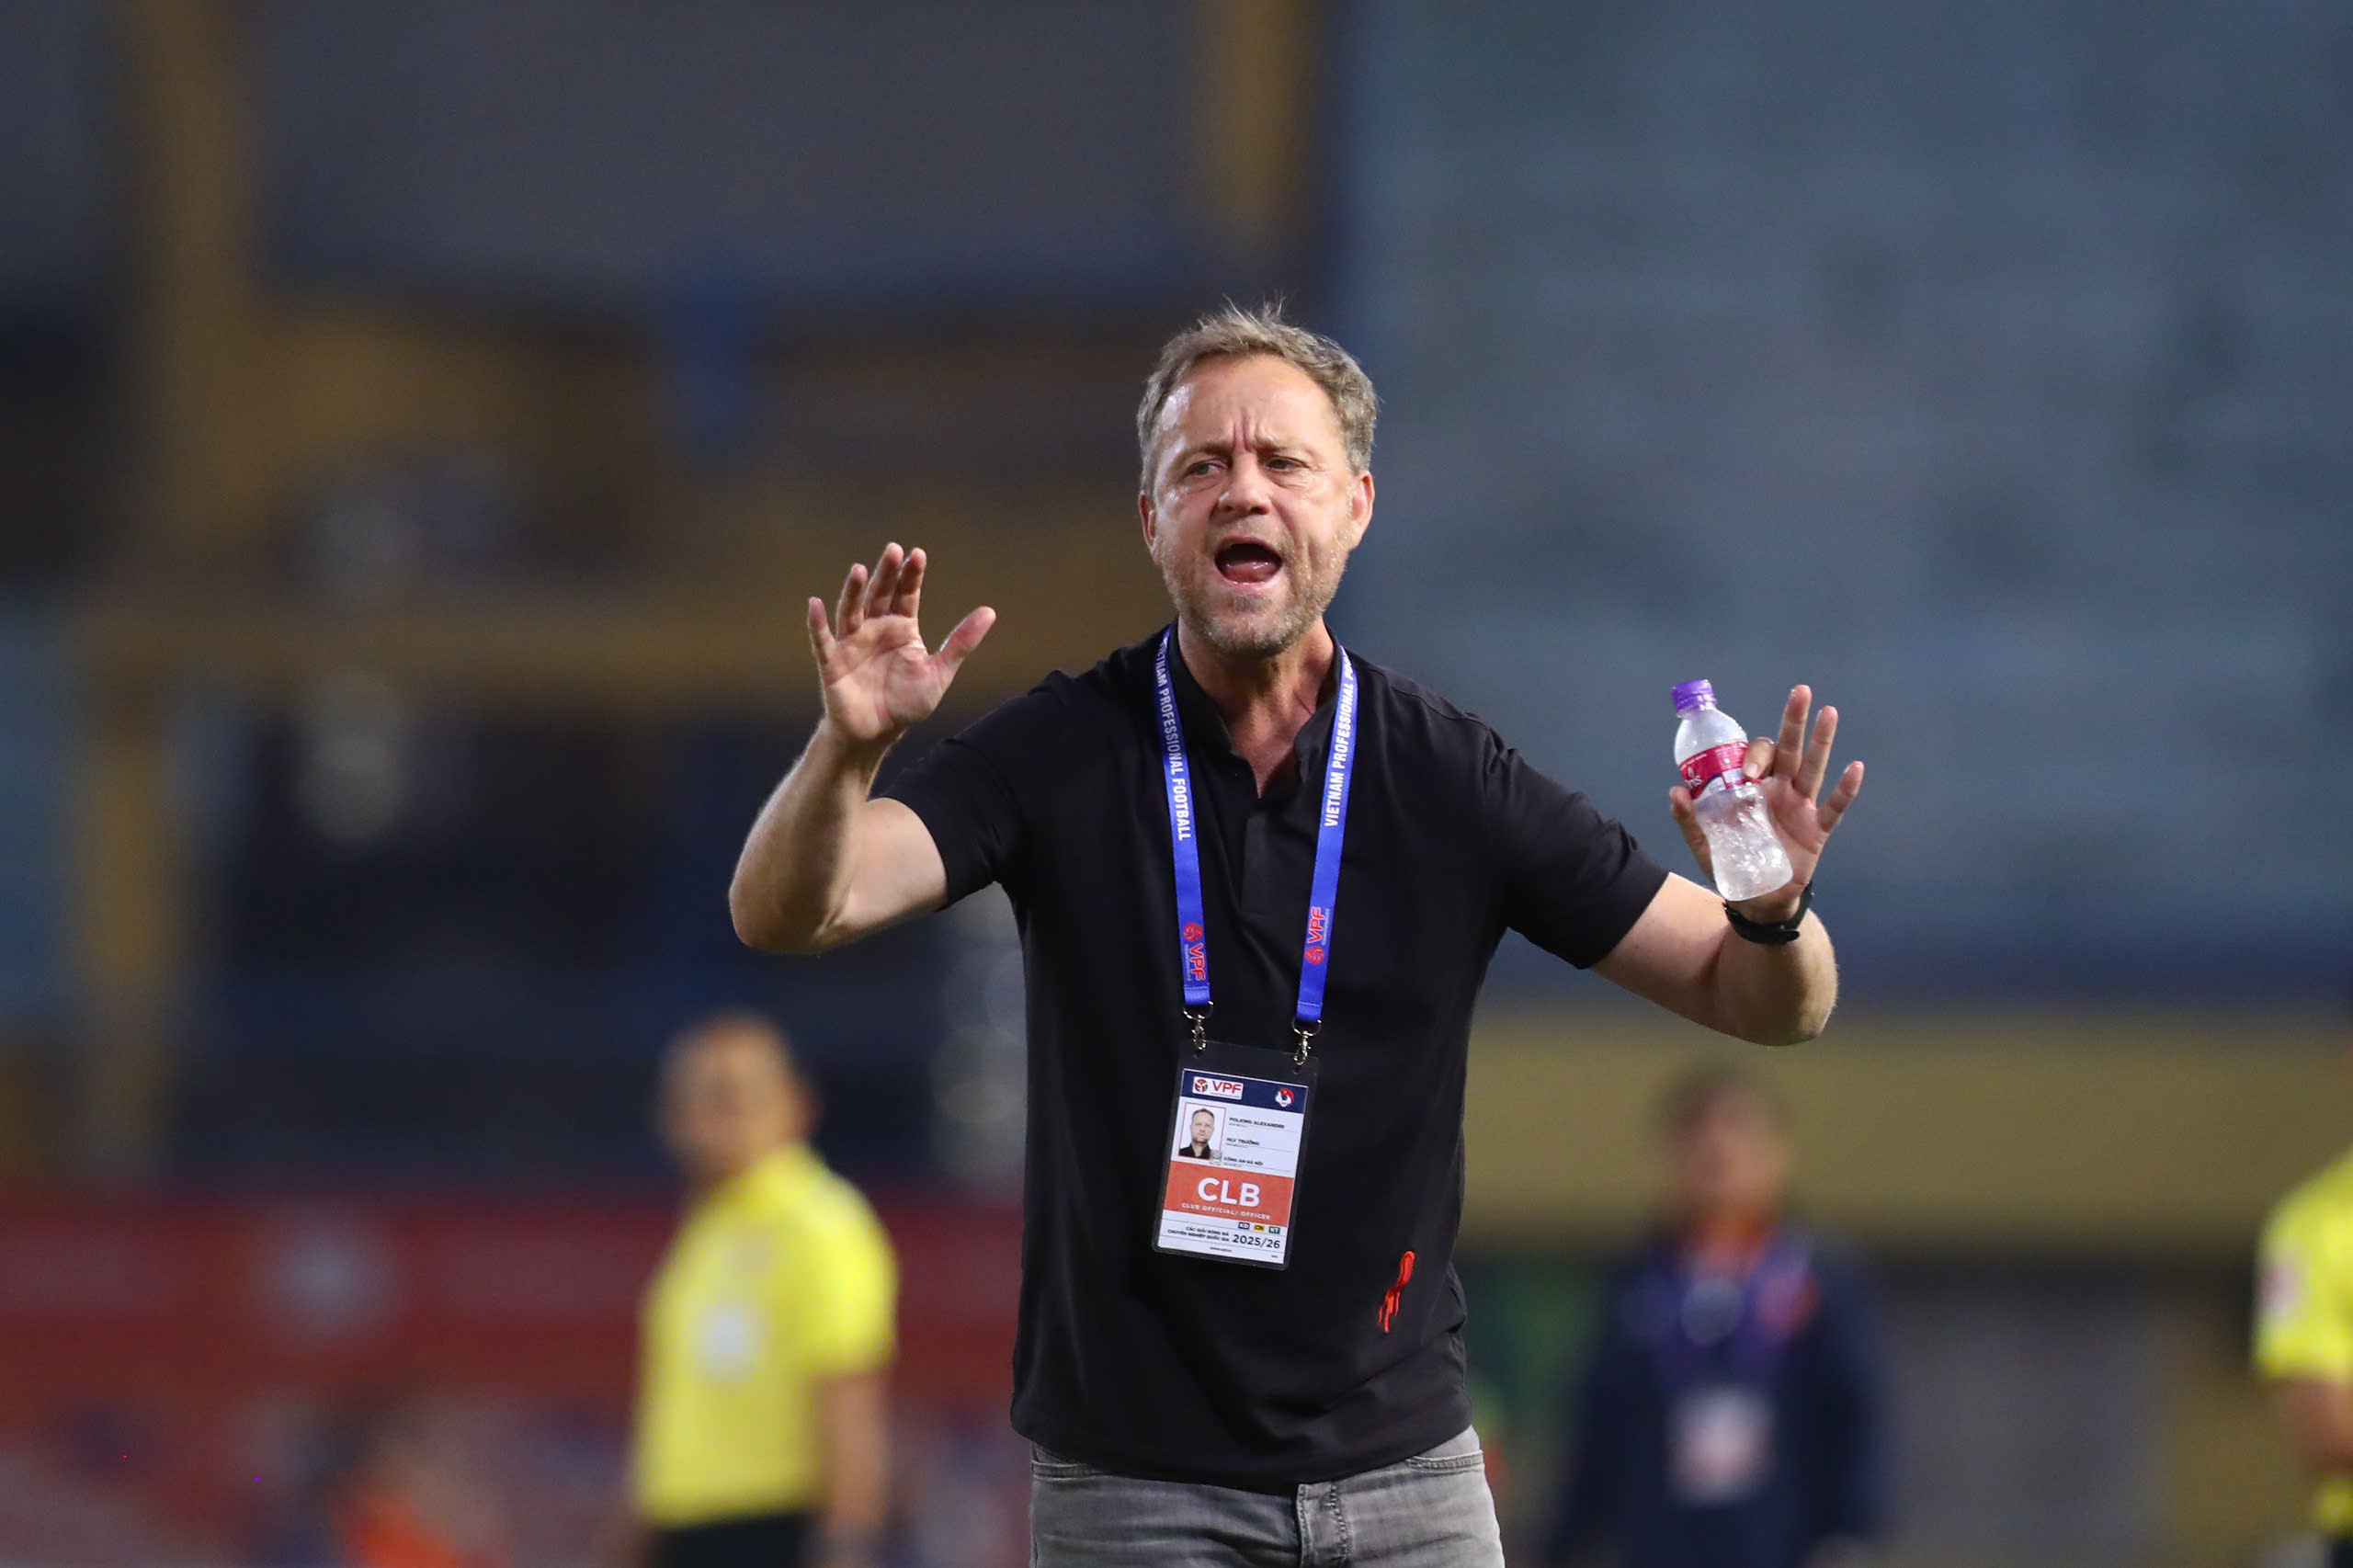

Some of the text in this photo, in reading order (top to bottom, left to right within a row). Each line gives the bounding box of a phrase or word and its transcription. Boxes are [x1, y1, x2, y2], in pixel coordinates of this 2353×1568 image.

[1333, 683, 1355, 769] PROFESSIONAL
[1159, 688, 1184, 775] PROFESSIONAL
[1173, 778, 1191, 841] FOOTBALL
[1324, 772, 1345, 827] VIETNAM
[1306, 906, 1325, 944] VPF
[1189, 943, 1206, 981] VPF
[1212, 1081, 1243, 1093] VPF
[1198, 1177, 1260, 1207] CLB
[1233, 1234, 1280, 1248] 2025/26
